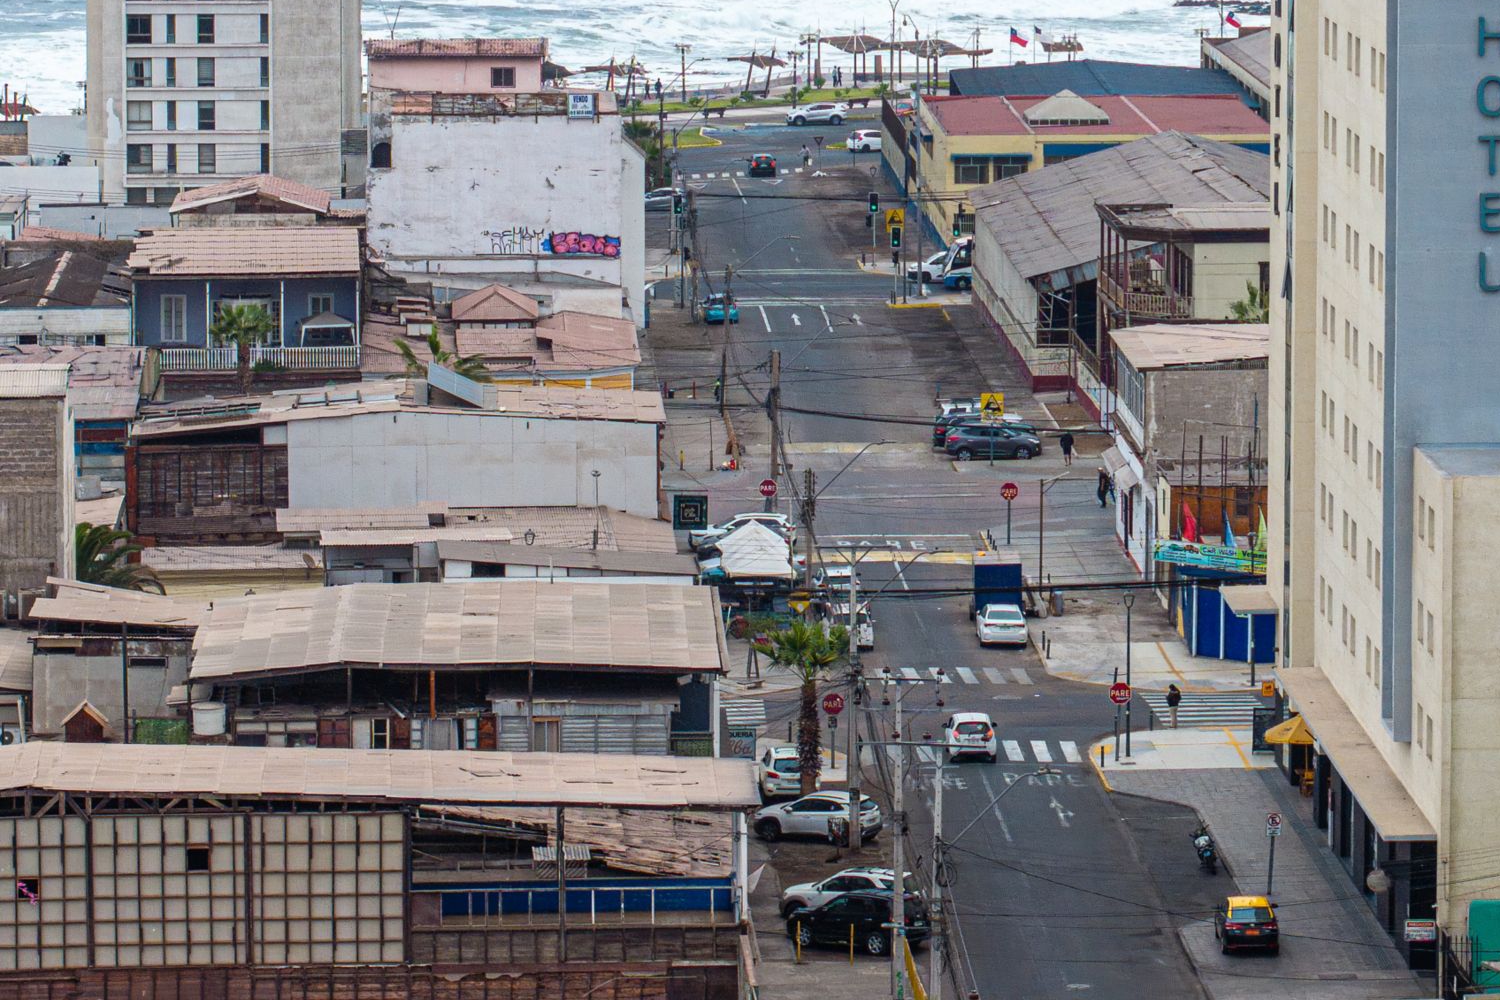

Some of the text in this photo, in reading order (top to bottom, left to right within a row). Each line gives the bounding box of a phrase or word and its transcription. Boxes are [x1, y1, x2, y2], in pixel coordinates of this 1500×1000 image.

[836, 540, 928, 550] PARE
[1110, 689, 1131, 697] PARE
[823, 700, 843, 708] PARE
